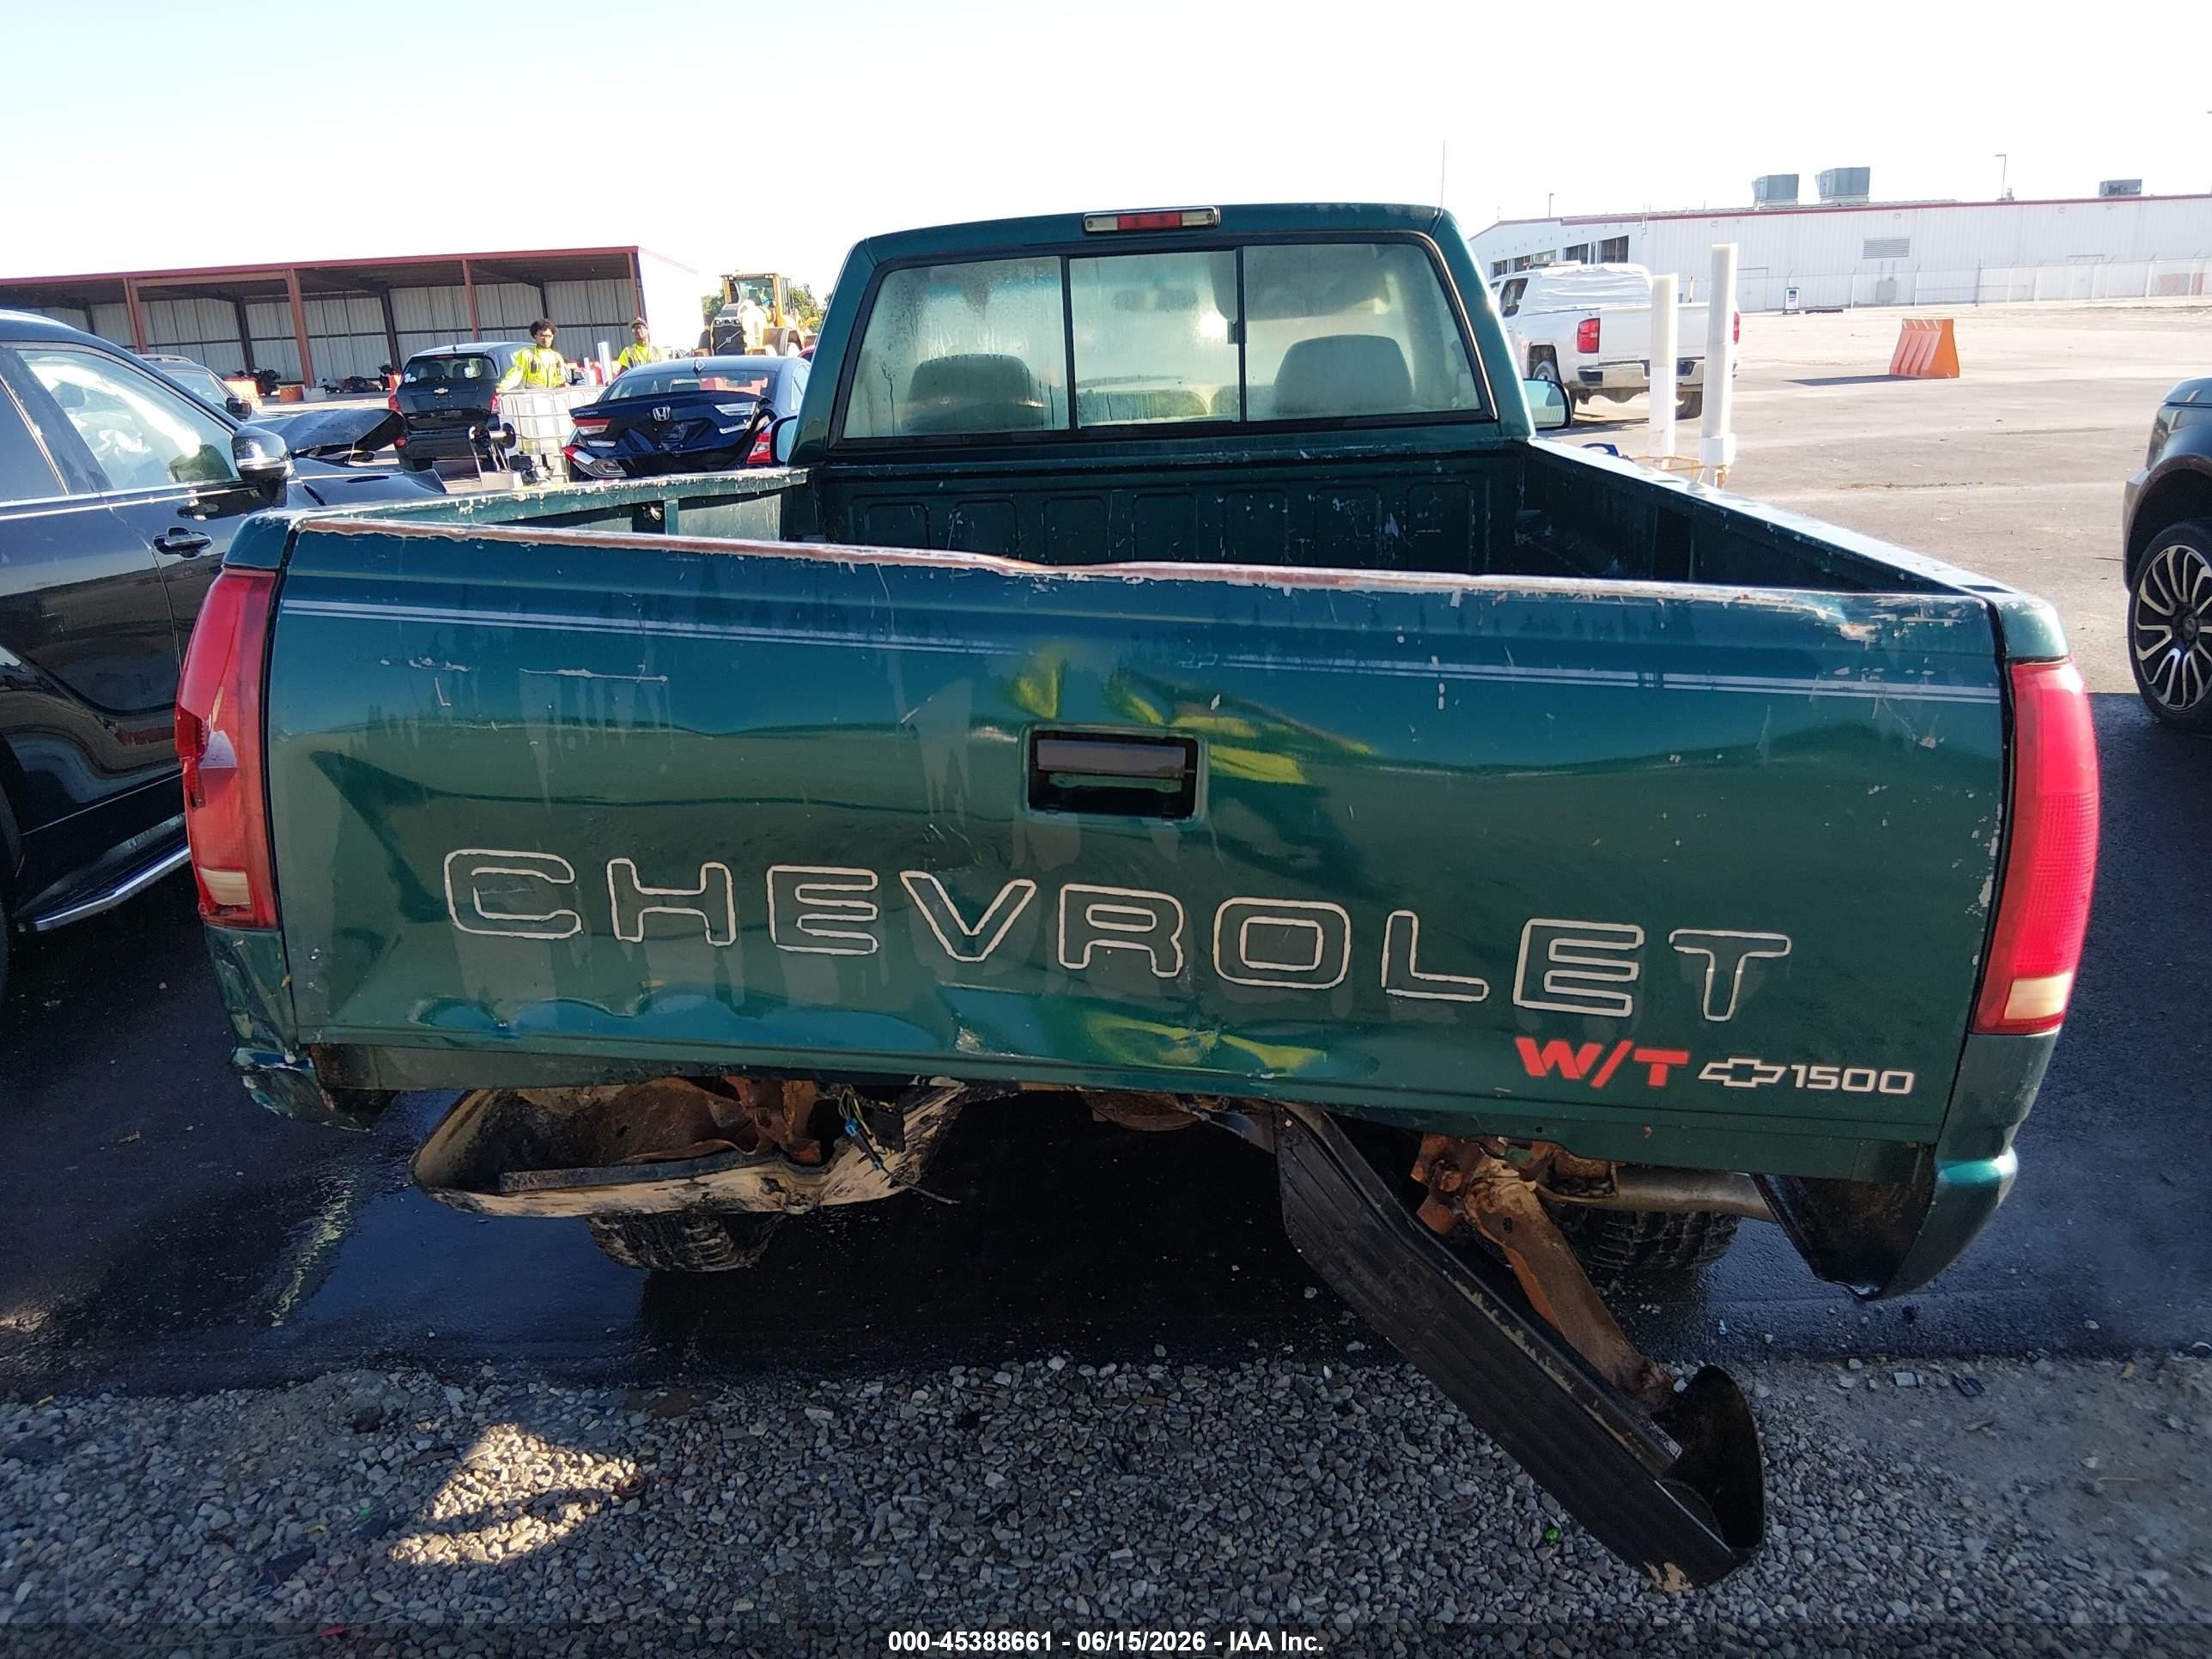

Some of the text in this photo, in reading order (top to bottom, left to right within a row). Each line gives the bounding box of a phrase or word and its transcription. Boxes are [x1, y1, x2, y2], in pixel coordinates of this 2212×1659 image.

[443, 848, 1792, 1022] CHEVROLET
[1515, 1036, 1915, 1095] W/T 1500
